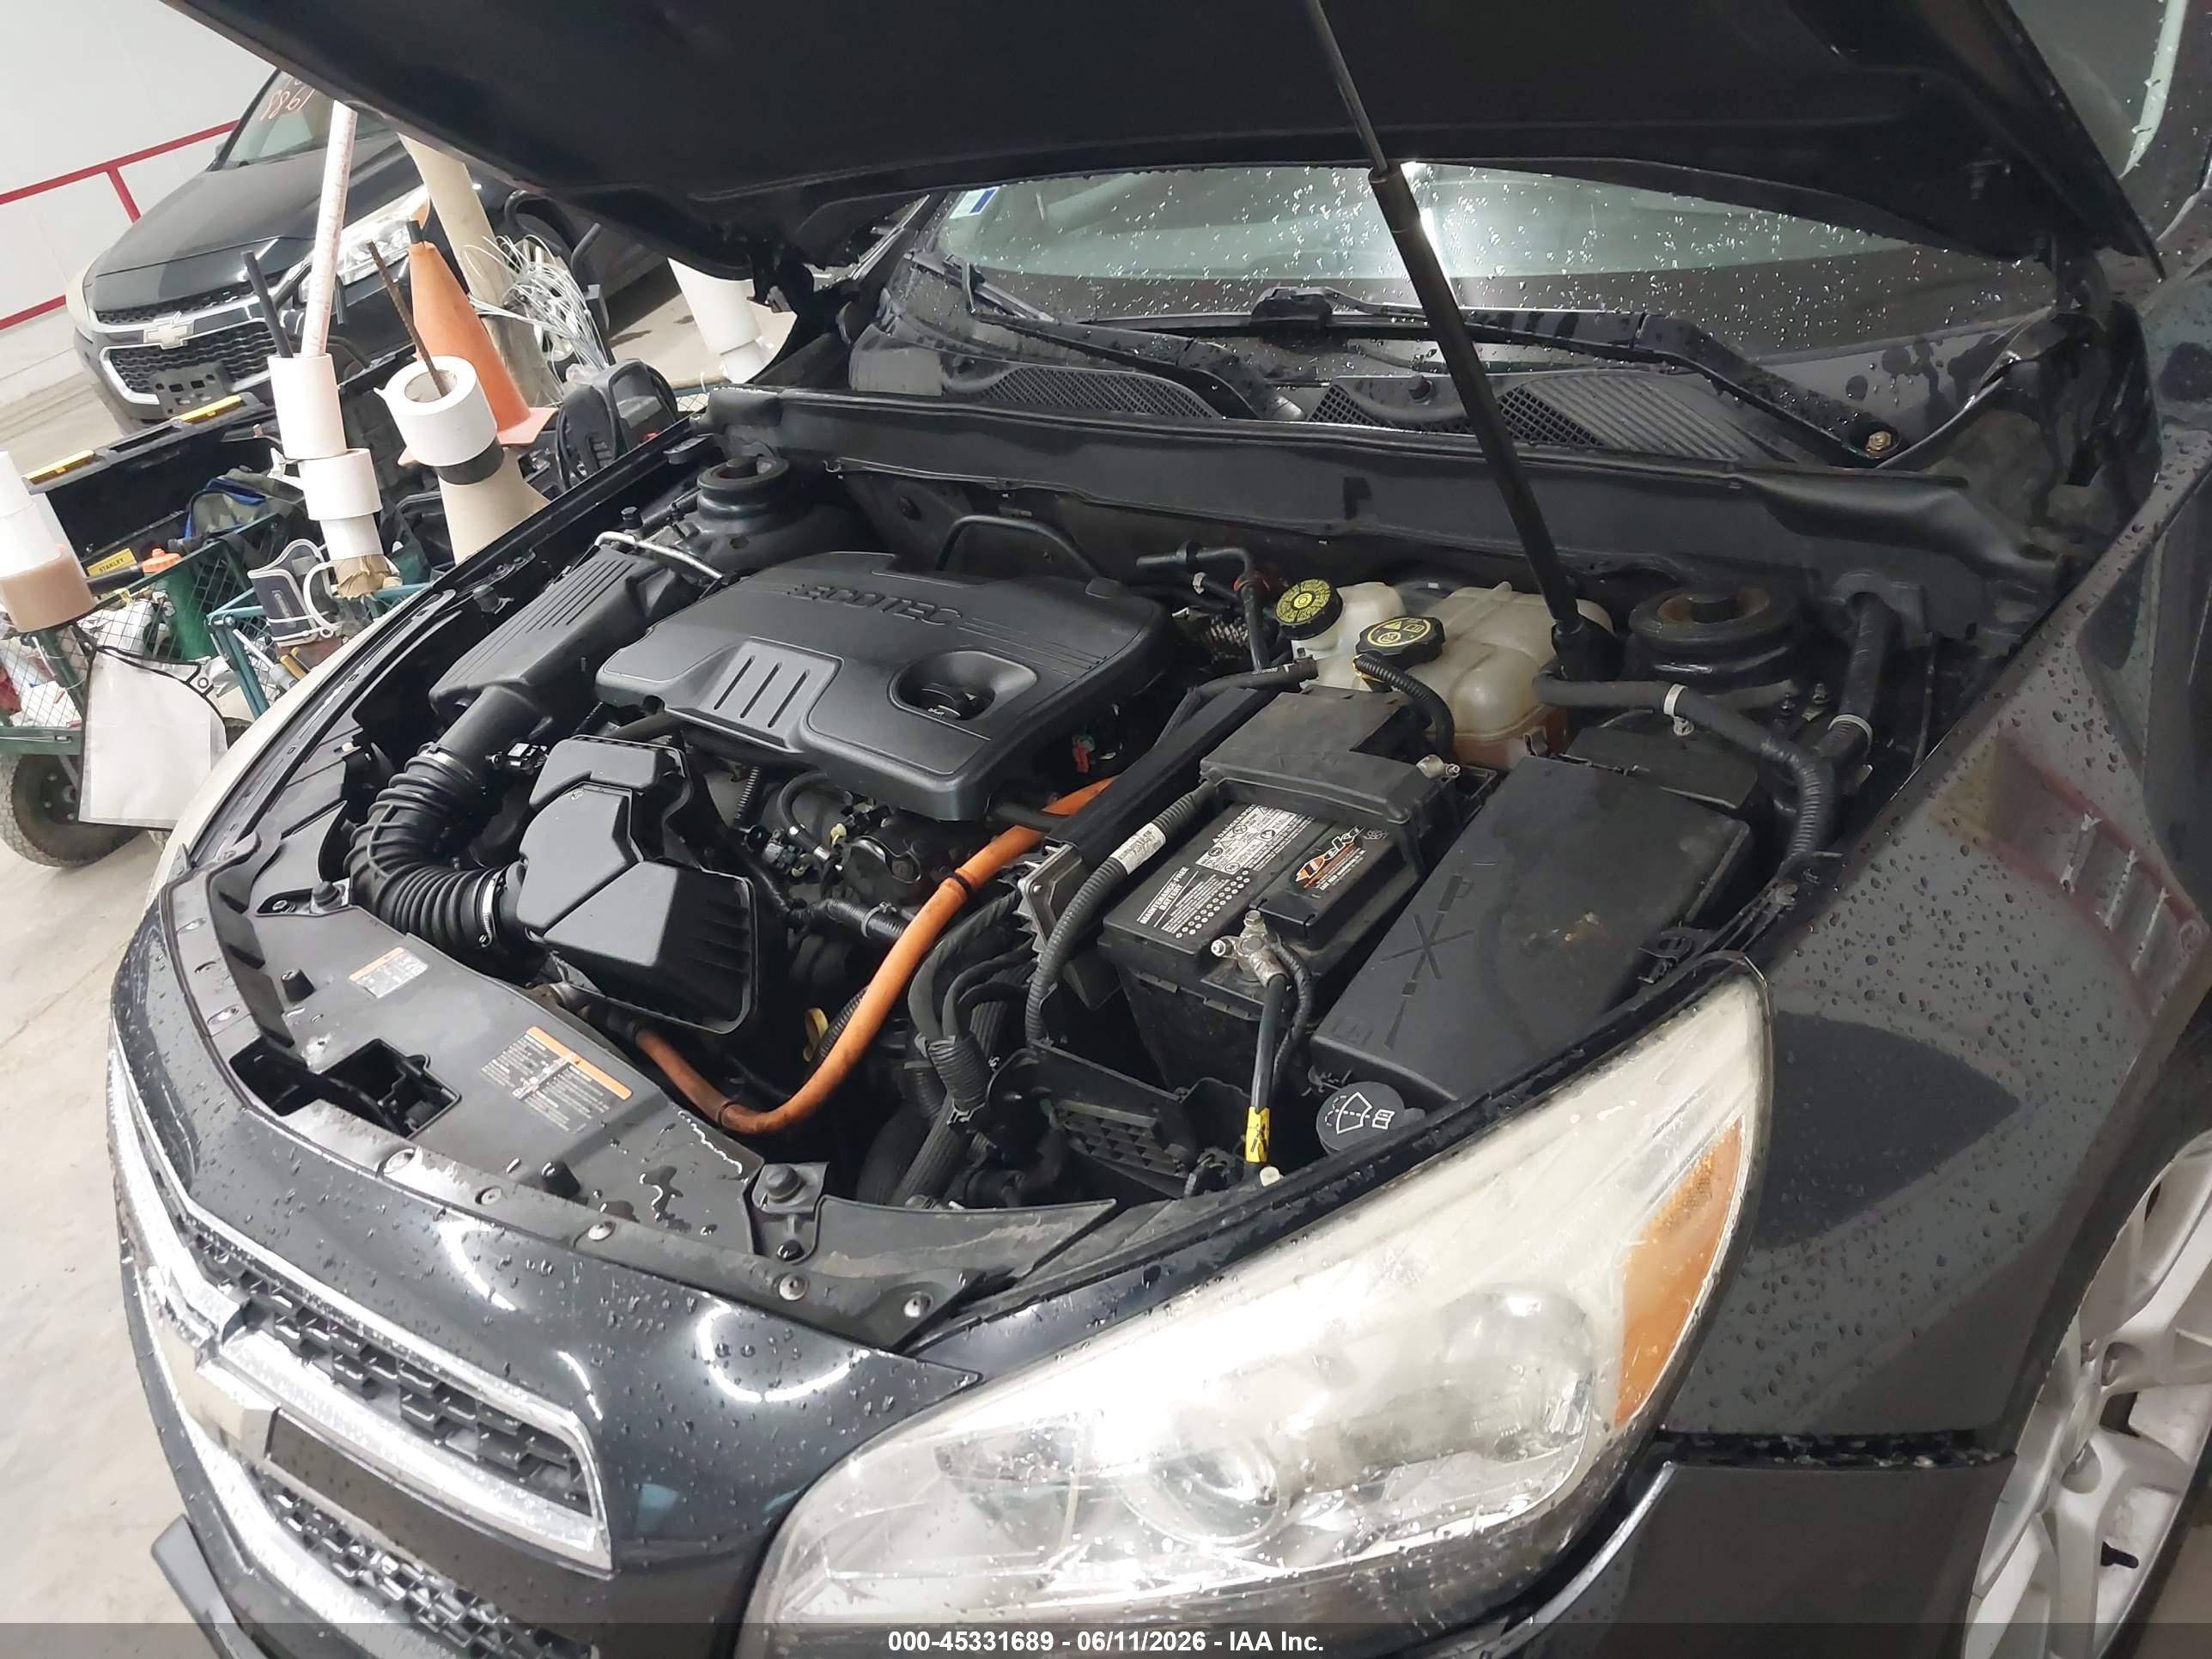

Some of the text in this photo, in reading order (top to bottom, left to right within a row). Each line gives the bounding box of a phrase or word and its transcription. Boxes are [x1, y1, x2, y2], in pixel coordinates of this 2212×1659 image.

[793, 585, 963, 625] ECOTEC
[1139, 866, 1189, 924] MAINTENANCE-FREE
[1160, 884, 1184, 911] BATTERY
